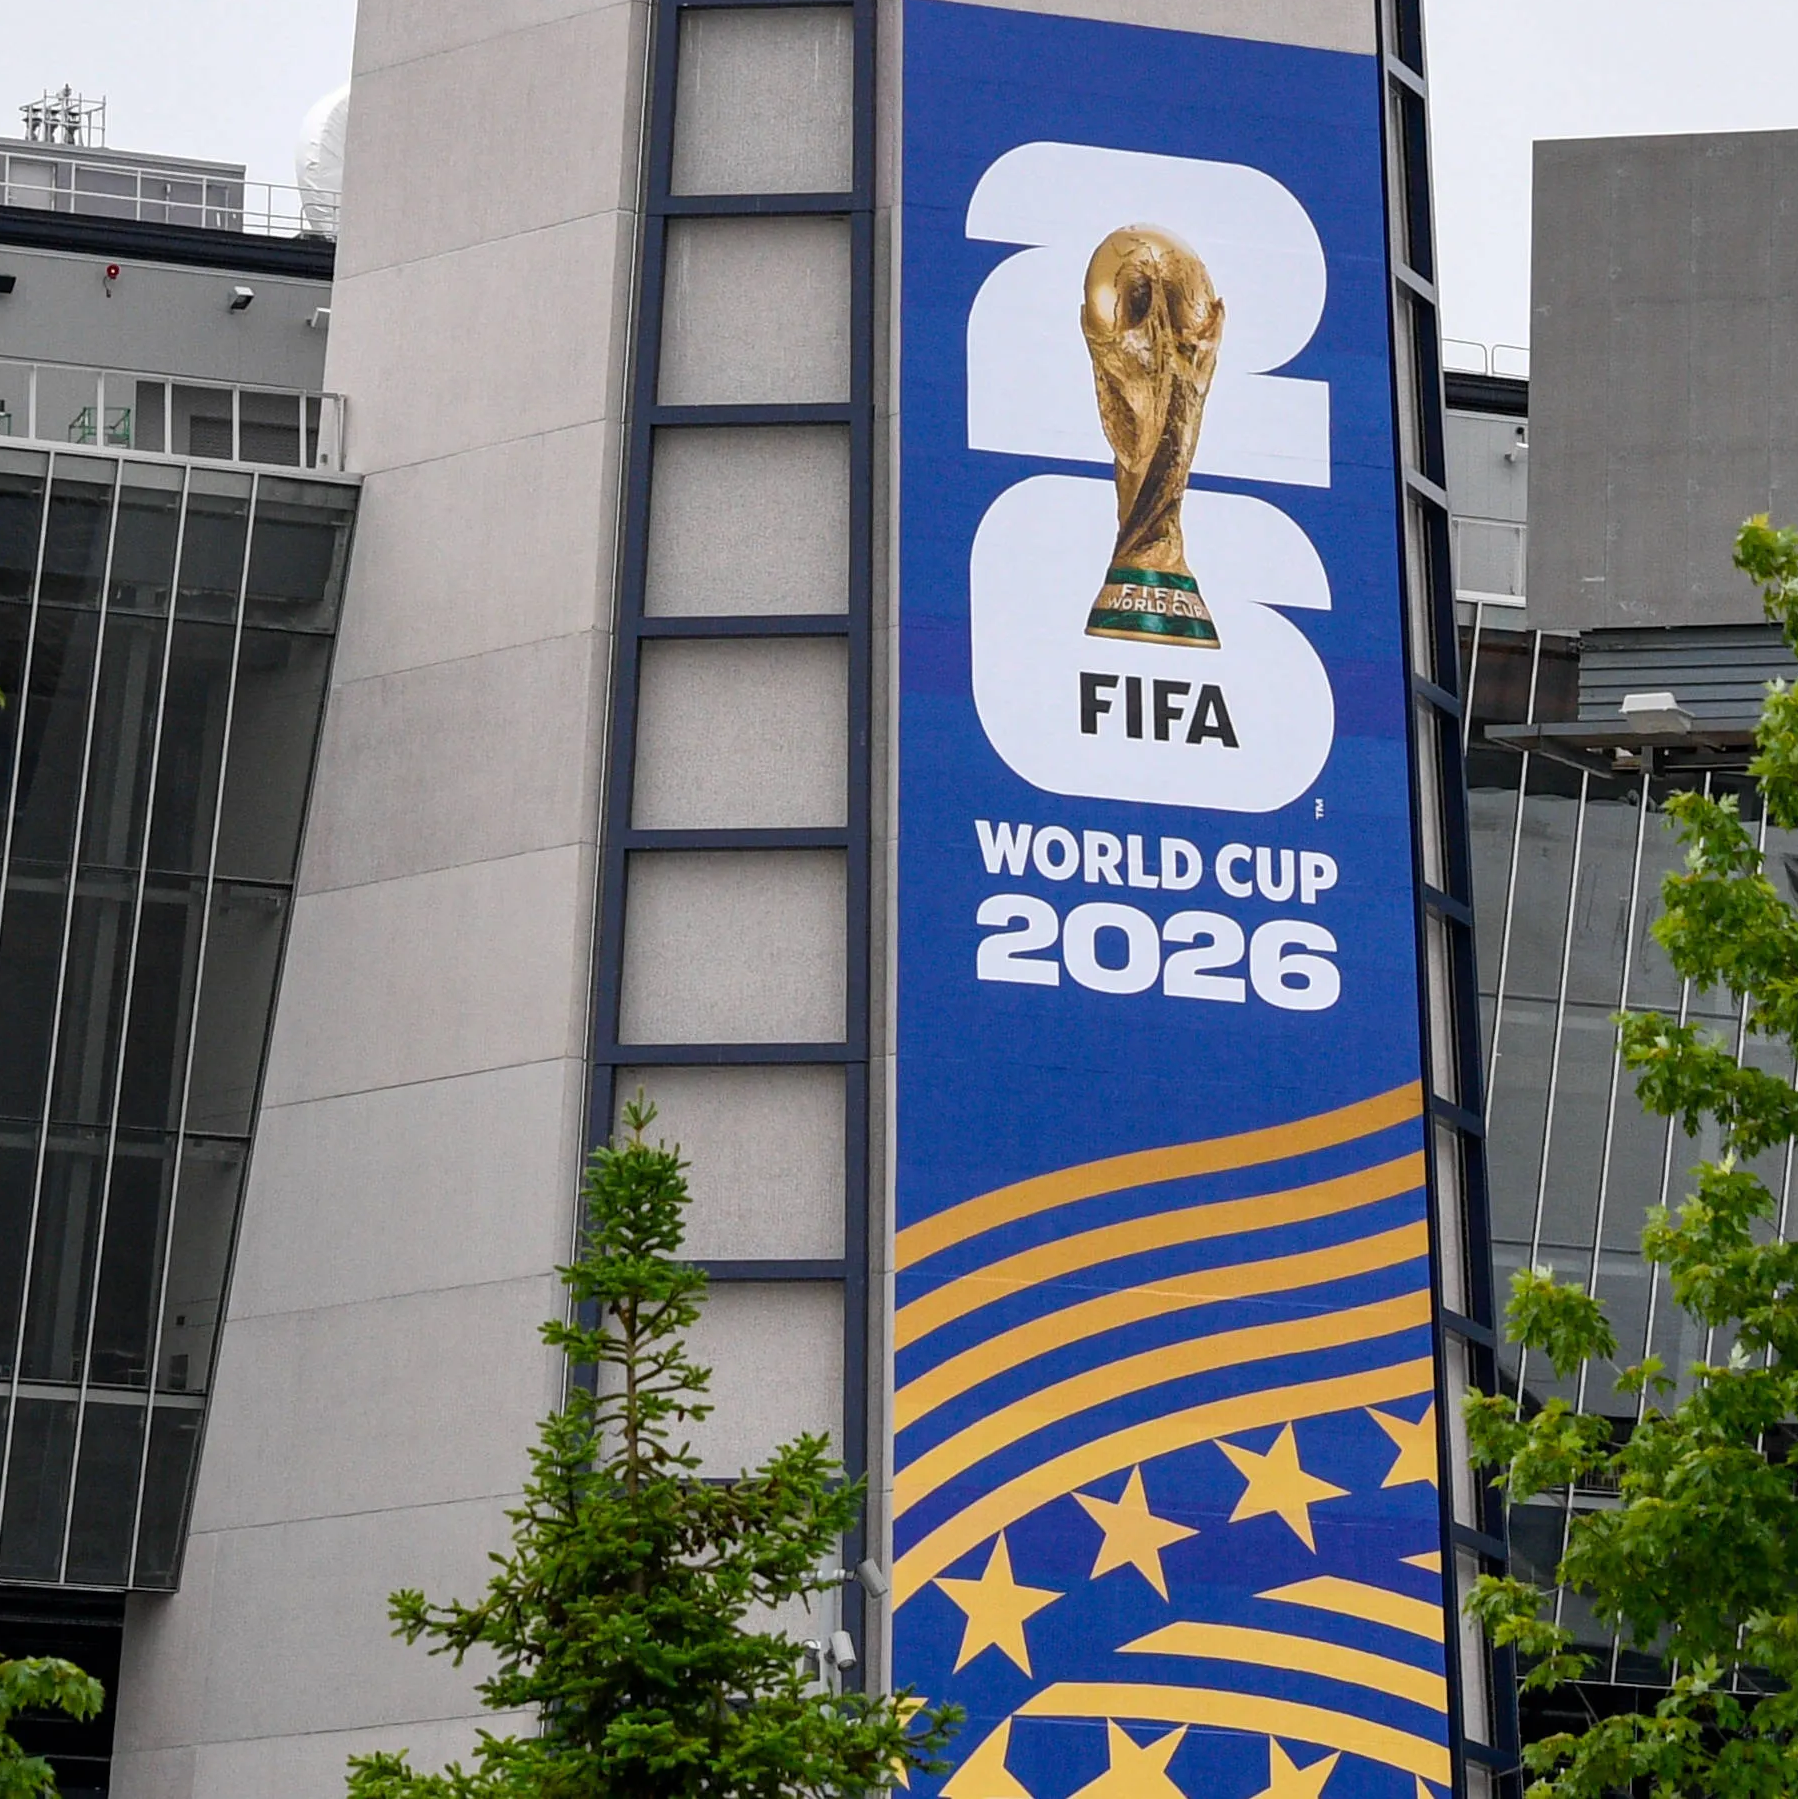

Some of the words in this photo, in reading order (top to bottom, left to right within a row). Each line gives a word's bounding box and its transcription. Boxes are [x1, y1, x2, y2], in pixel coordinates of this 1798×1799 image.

[1108, 598, 1166, 614] WORLD
[1172, 602, 1203, 618] CUP
[1121, 583, 1186, 601] FIFA
[1079, 671, 1240, 749] FIFA
[1315, 798, 1325, 820] TM
[974, 819, 1203, 891] WORLD
[1215, 842, 1338, 904] CUP
[976, 893, 1341, 1011] 2026
